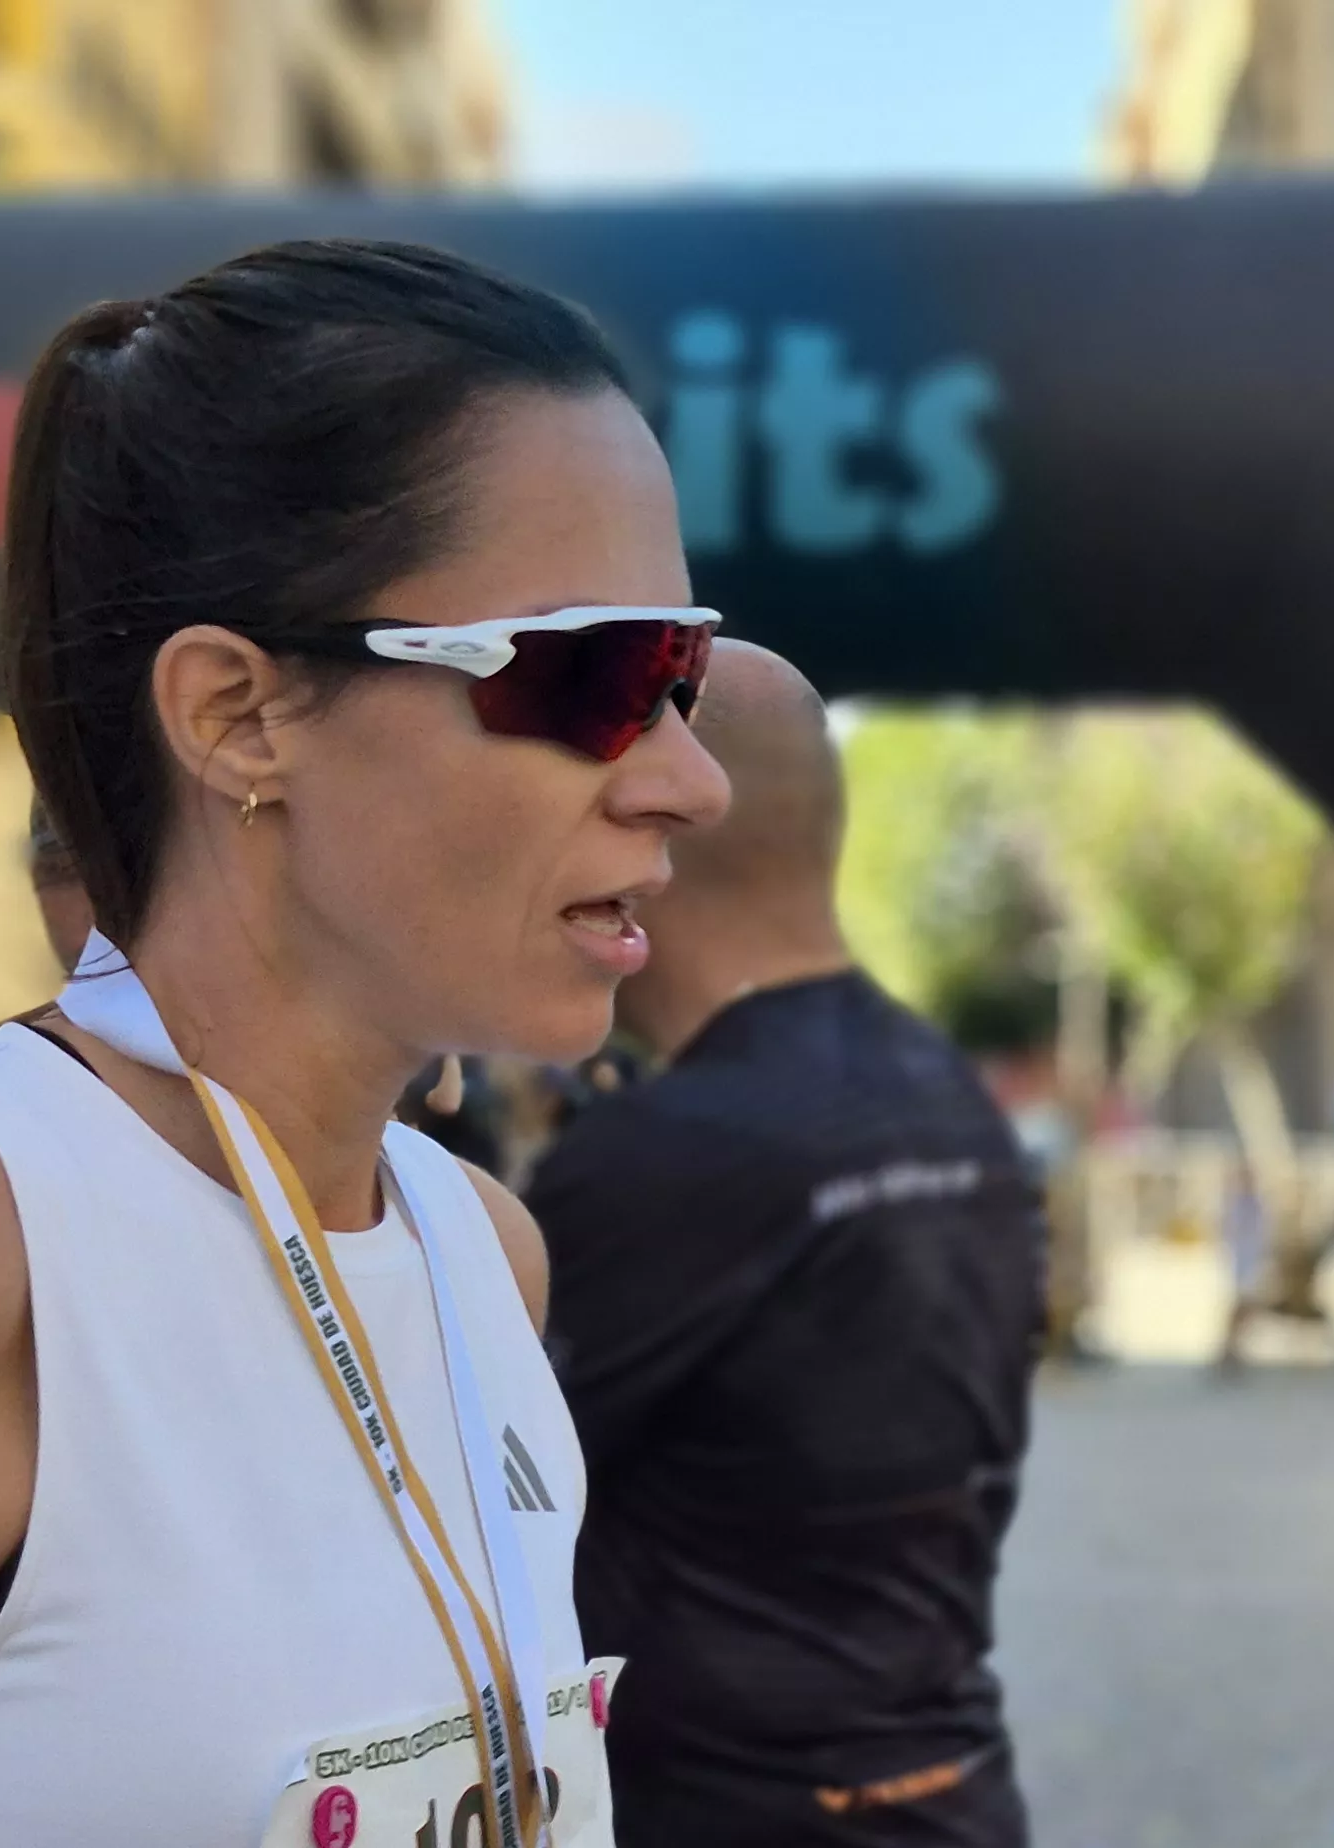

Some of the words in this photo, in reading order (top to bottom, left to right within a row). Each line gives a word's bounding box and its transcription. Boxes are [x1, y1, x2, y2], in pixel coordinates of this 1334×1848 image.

[283, 1234, 327, 1311] HUESCA
[317, 1310, 340, 1339] DE
[331, 1340, 371, 1411] CIUDAD
[365, 1413, 386, 1450] 10K
